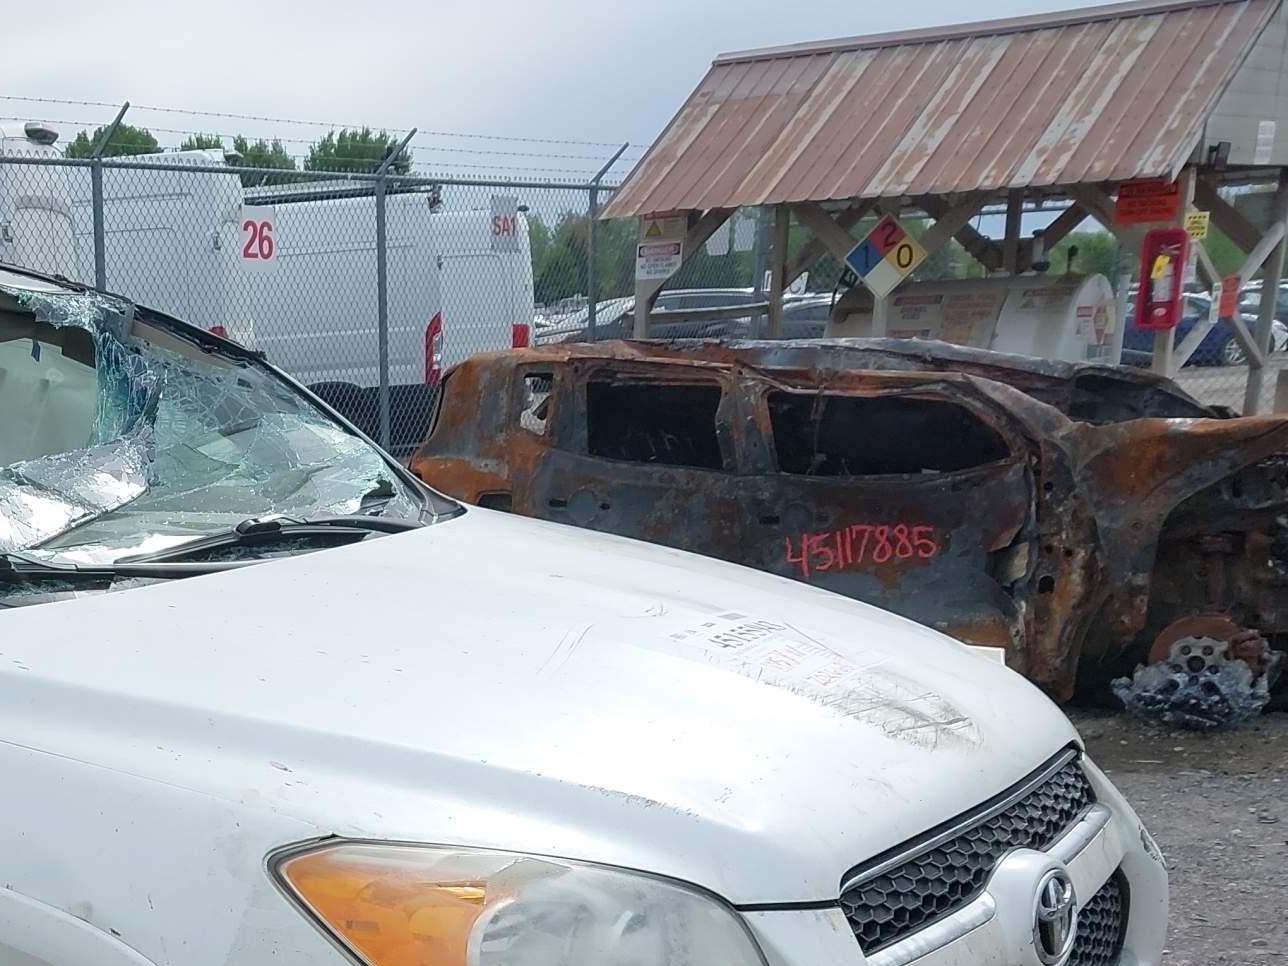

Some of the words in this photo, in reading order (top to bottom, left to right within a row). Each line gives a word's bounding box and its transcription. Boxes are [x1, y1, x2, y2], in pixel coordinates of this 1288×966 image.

[243, 220, 274, 260] 26
[881, 221, 898, 248] 2
[862, 245, 870, 269] 1
[896, 243, 913, 268] 0
[785, 523, 937, 577] 45117885
